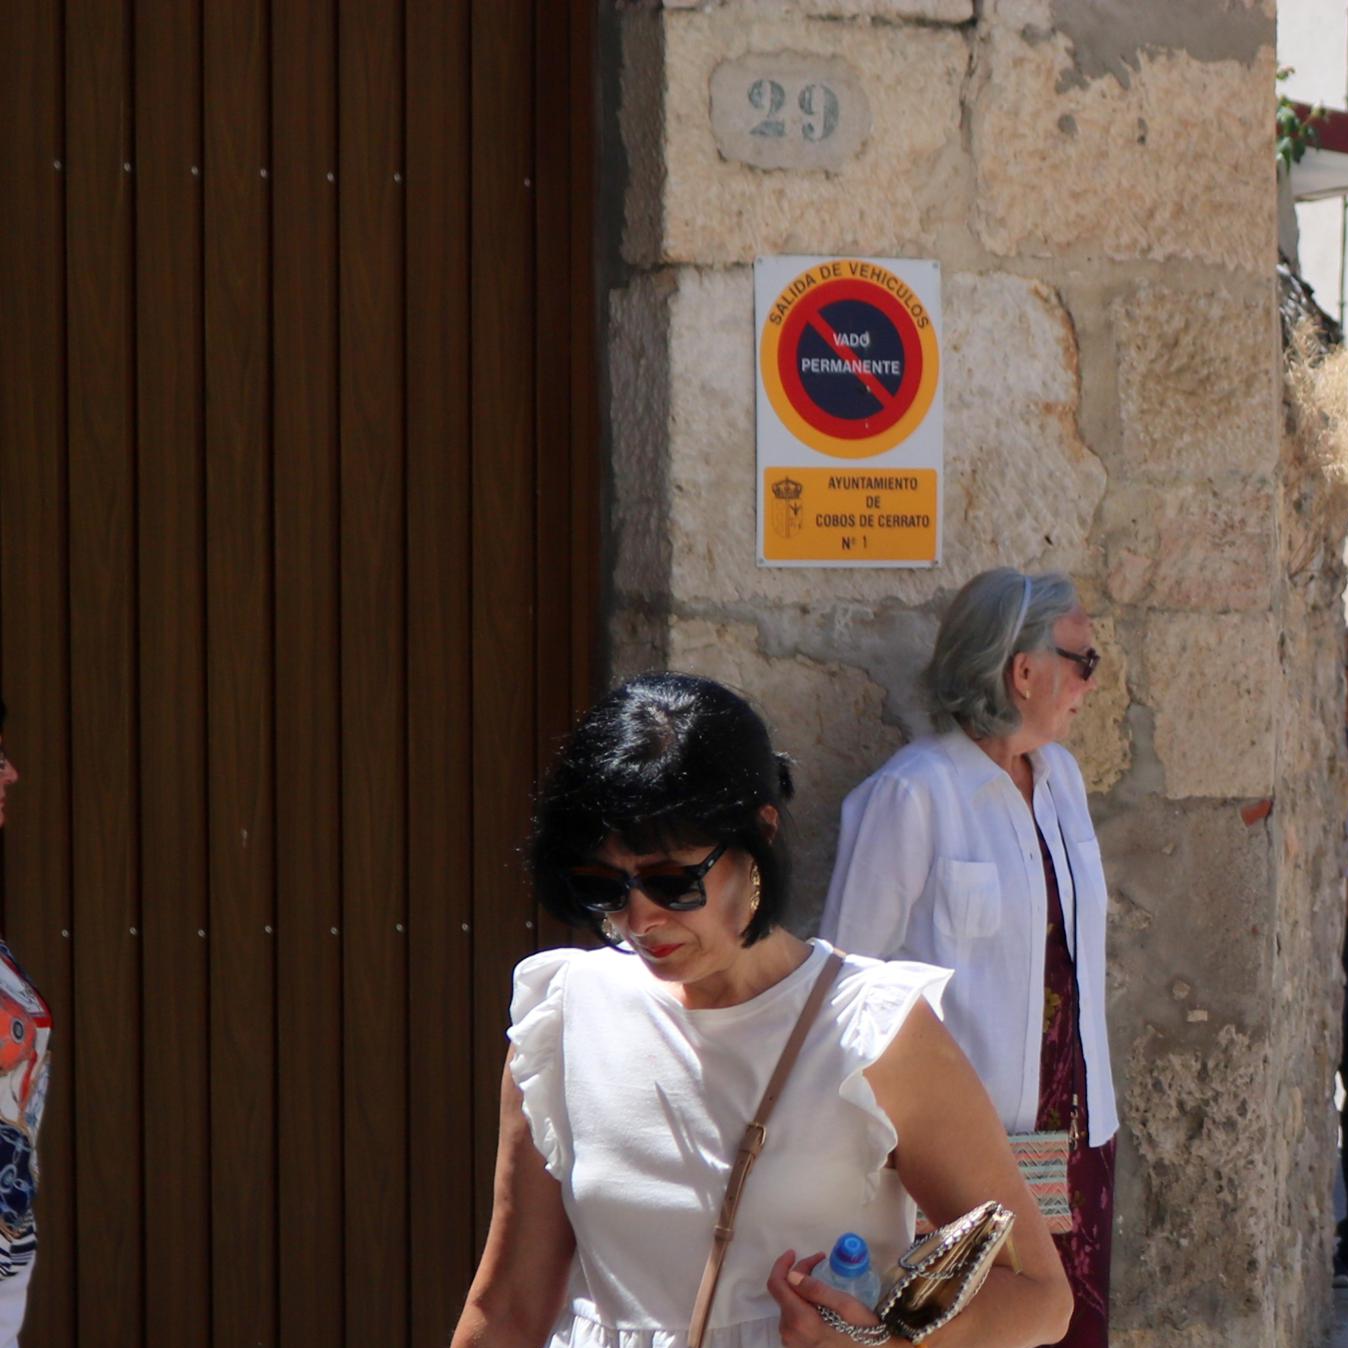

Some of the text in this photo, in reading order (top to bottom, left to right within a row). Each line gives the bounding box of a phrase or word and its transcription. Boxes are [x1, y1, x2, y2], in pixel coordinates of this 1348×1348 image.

[747, 79, 840, 143] 29
[769, 263, 930, 329] SALIDA DE VEHICULOS
[833, 333, 870, 347] VADO
[801, 358, 900, 375] PERMANENTE
[828, 476, 918, 490] AYUNTAMIENTO
[866, 496, 881, 509] DE
[815, 514, 930, 528] COBOS DE CERRATO
